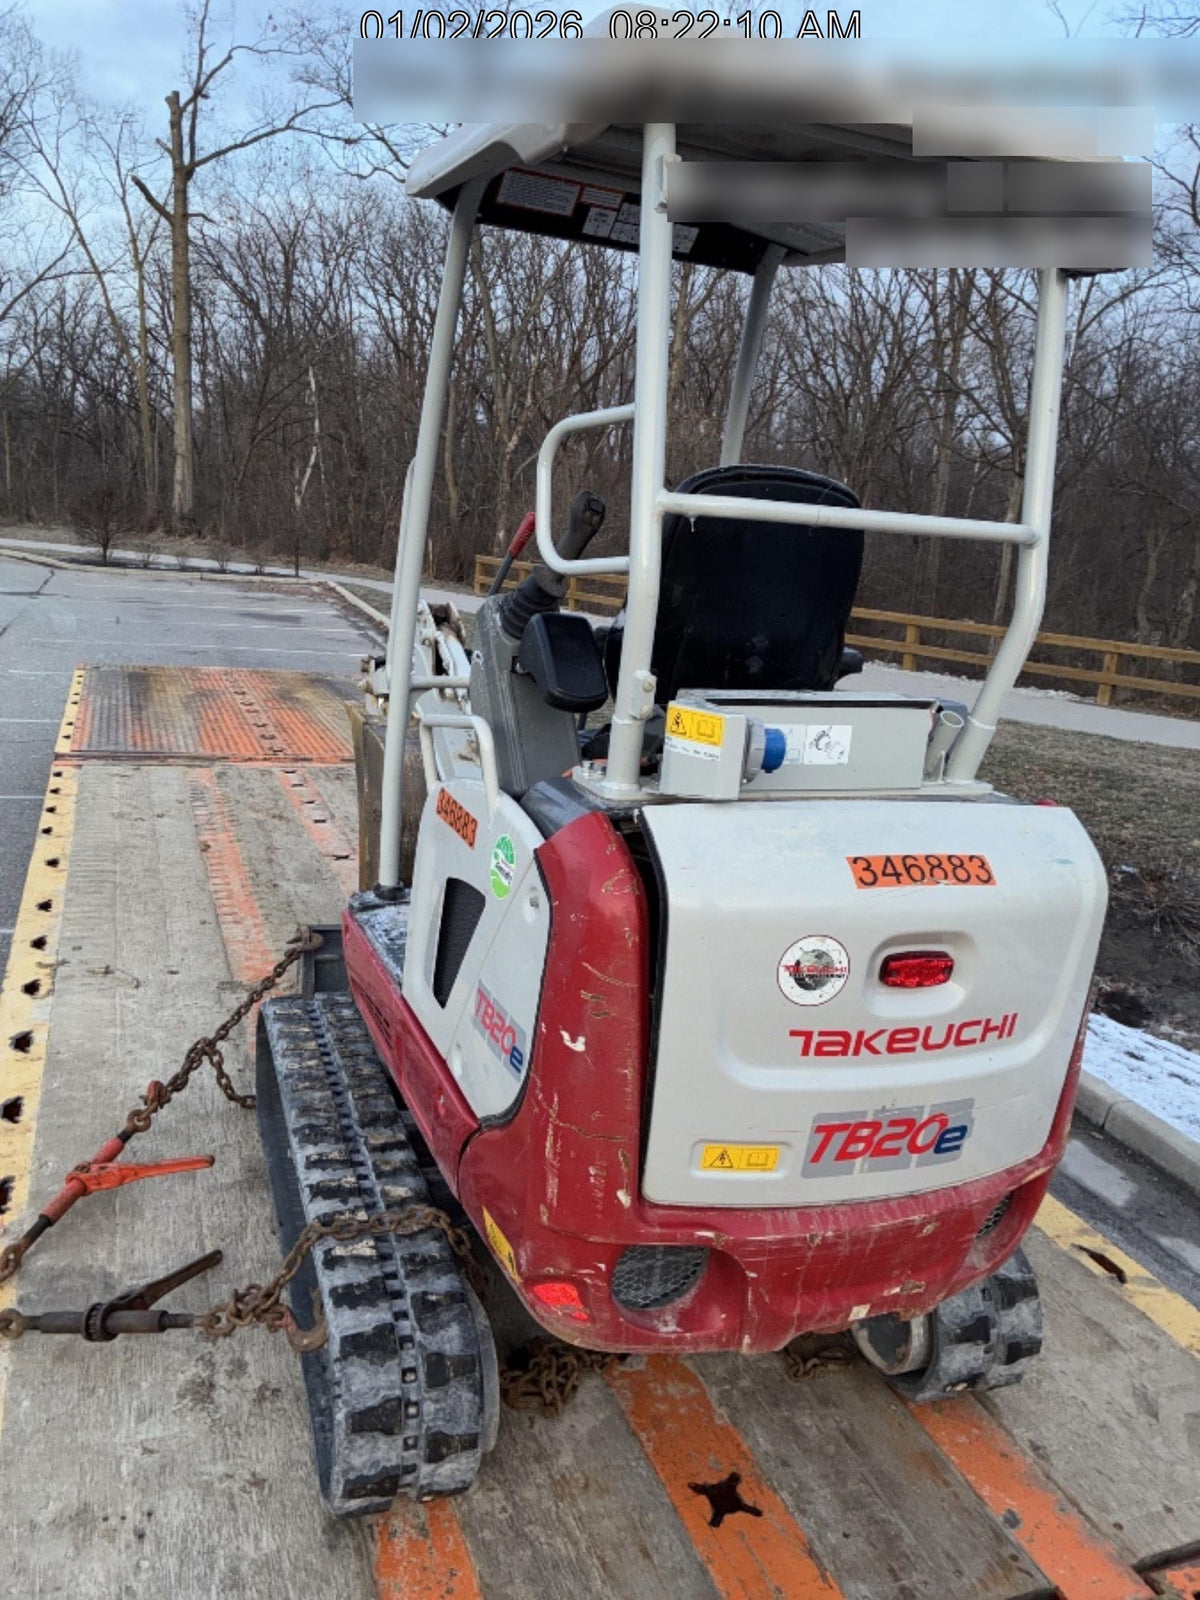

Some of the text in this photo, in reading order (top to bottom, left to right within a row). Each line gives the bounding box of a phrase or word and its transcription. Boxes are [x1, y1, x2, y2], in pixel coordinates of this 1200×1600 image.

[436, 787, 478, 848] 346883
[852, 854, 994, 887] 346883
[474, 988, 525, 1074] TB20e
[788, 1012, 1019, 1058] TAKEUCHI
[809, 1111, 969, 1164] TB20e
